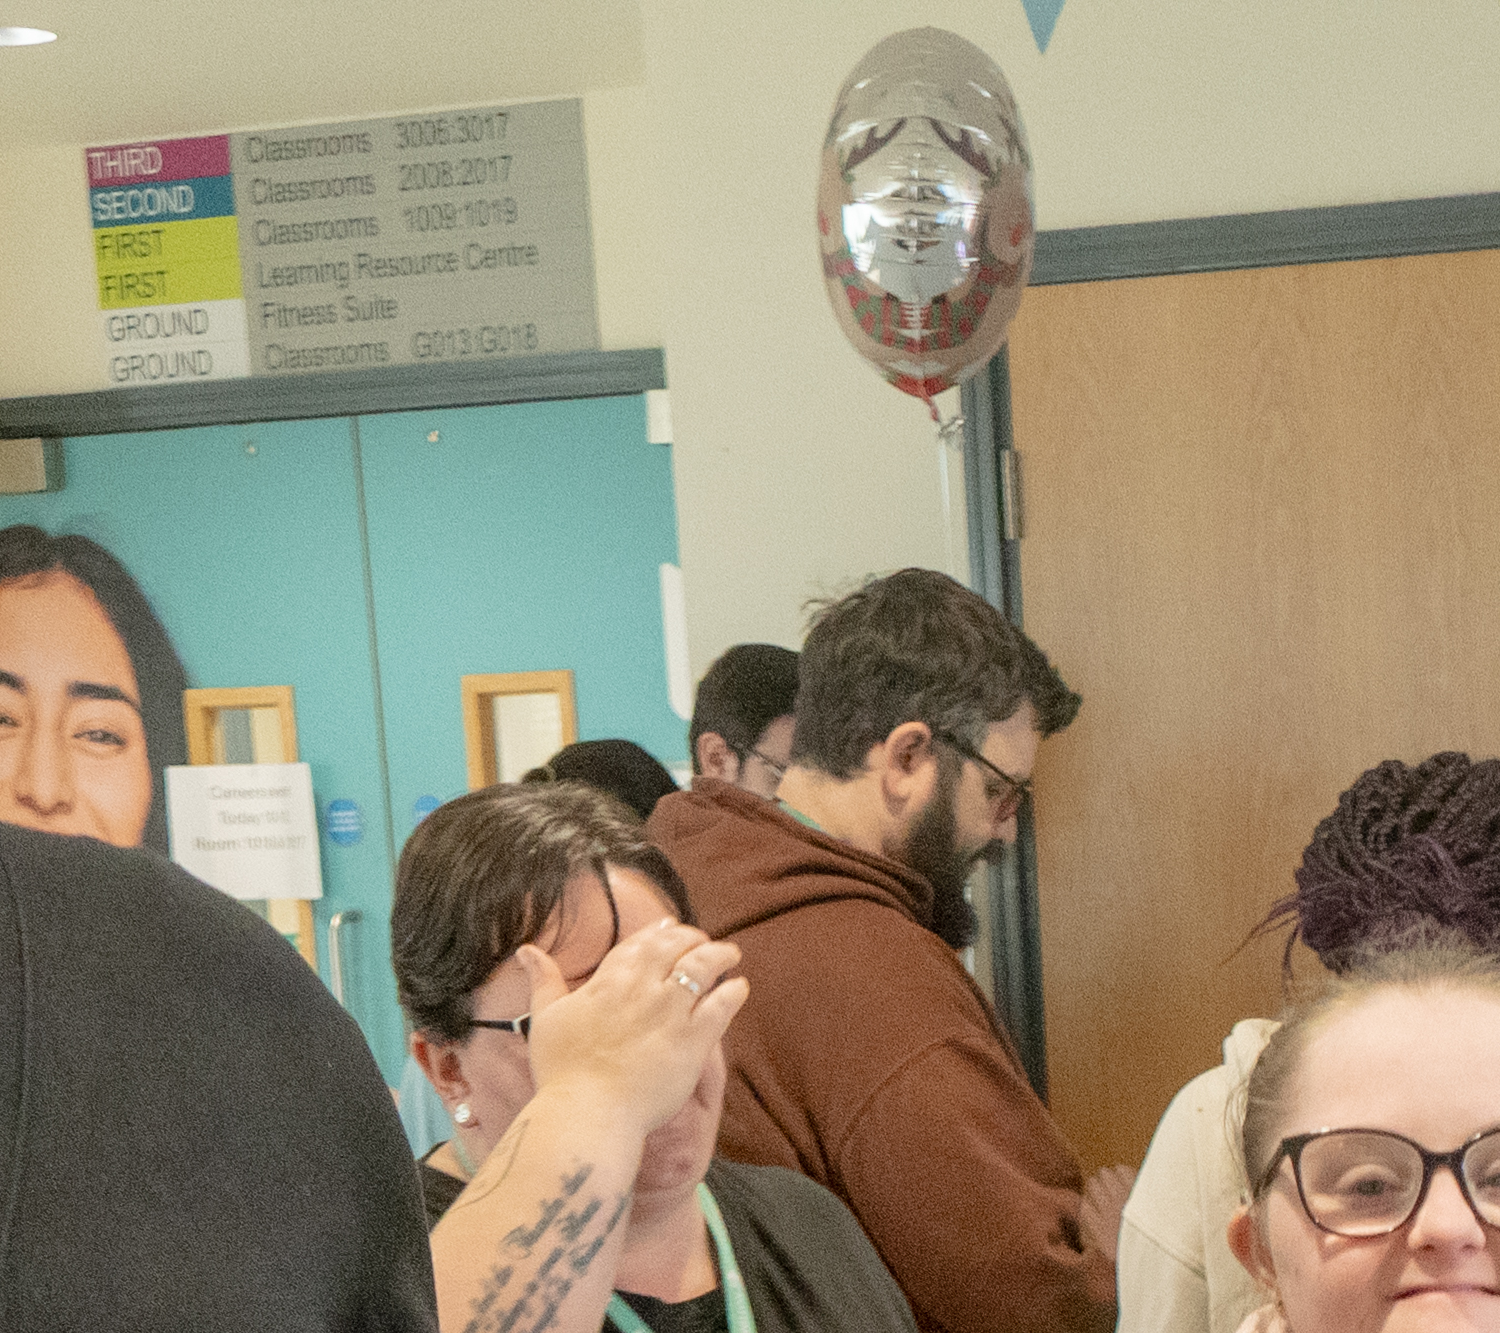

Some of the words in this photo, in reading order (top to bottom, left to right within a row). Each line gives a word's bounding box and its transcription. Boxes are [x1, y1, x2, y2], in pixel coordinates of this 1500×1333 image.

[88, 146, 163, 178] THIRD
[246, 132, 373, 163] Classrooms
[92, 184, 194, 220] SECOND
[250, 174, 376, 206] Classrooms
[98, 229, 164, 258] FIRST
[254, 216, 381, 246] Classrooms
[257, 260, 350, 289] Learning
[356, 252, 460, 280] Resource
[464, 242, 539, 271] Centre
[101, 270, 167, 300] FIRST
[107, 308, 210, 342] GROUND
[261, 302, 338, 328] Fitness
[343, 295, 399, 323] Suite
[111, 349, 213, 383] GROUND
[265, 342, 391, 370] Classrooms
